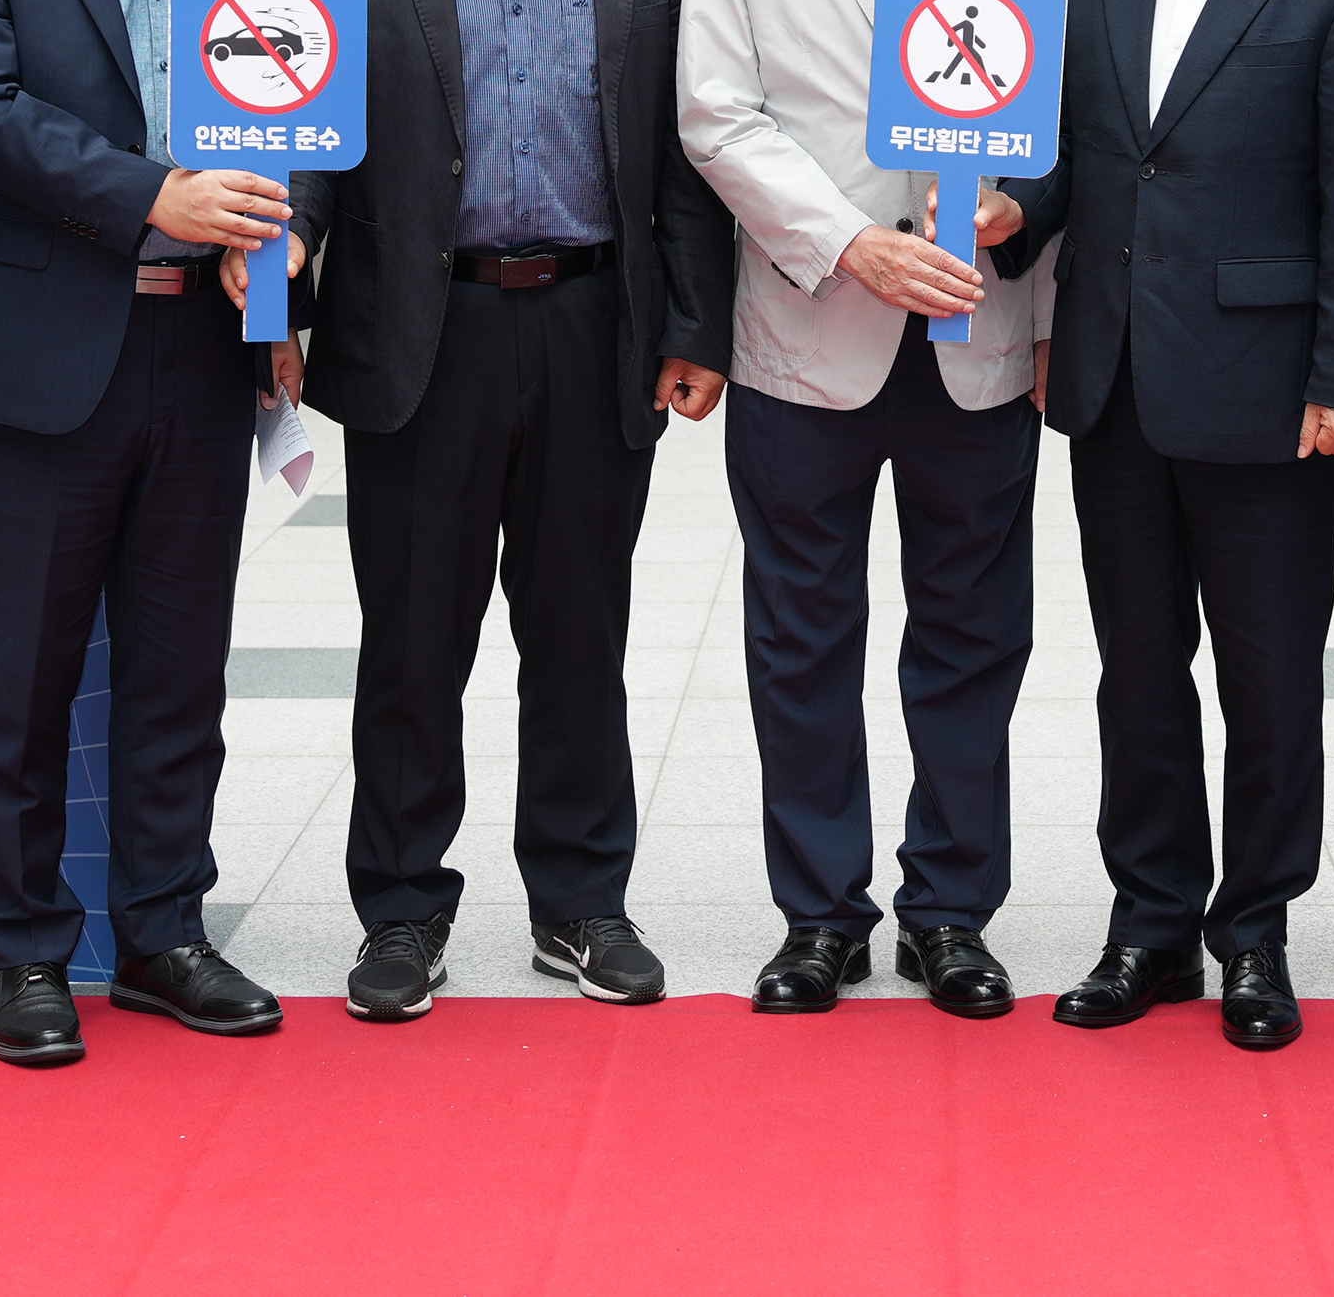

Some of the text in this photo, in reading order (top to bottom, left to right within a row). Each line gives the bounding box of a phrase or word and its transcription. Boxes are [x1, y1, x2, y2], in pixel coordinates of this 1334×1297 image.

[194, 125, 341, 151] 안전속도 준수
[889, 125, 1033, 158] 무단횡단 금지
